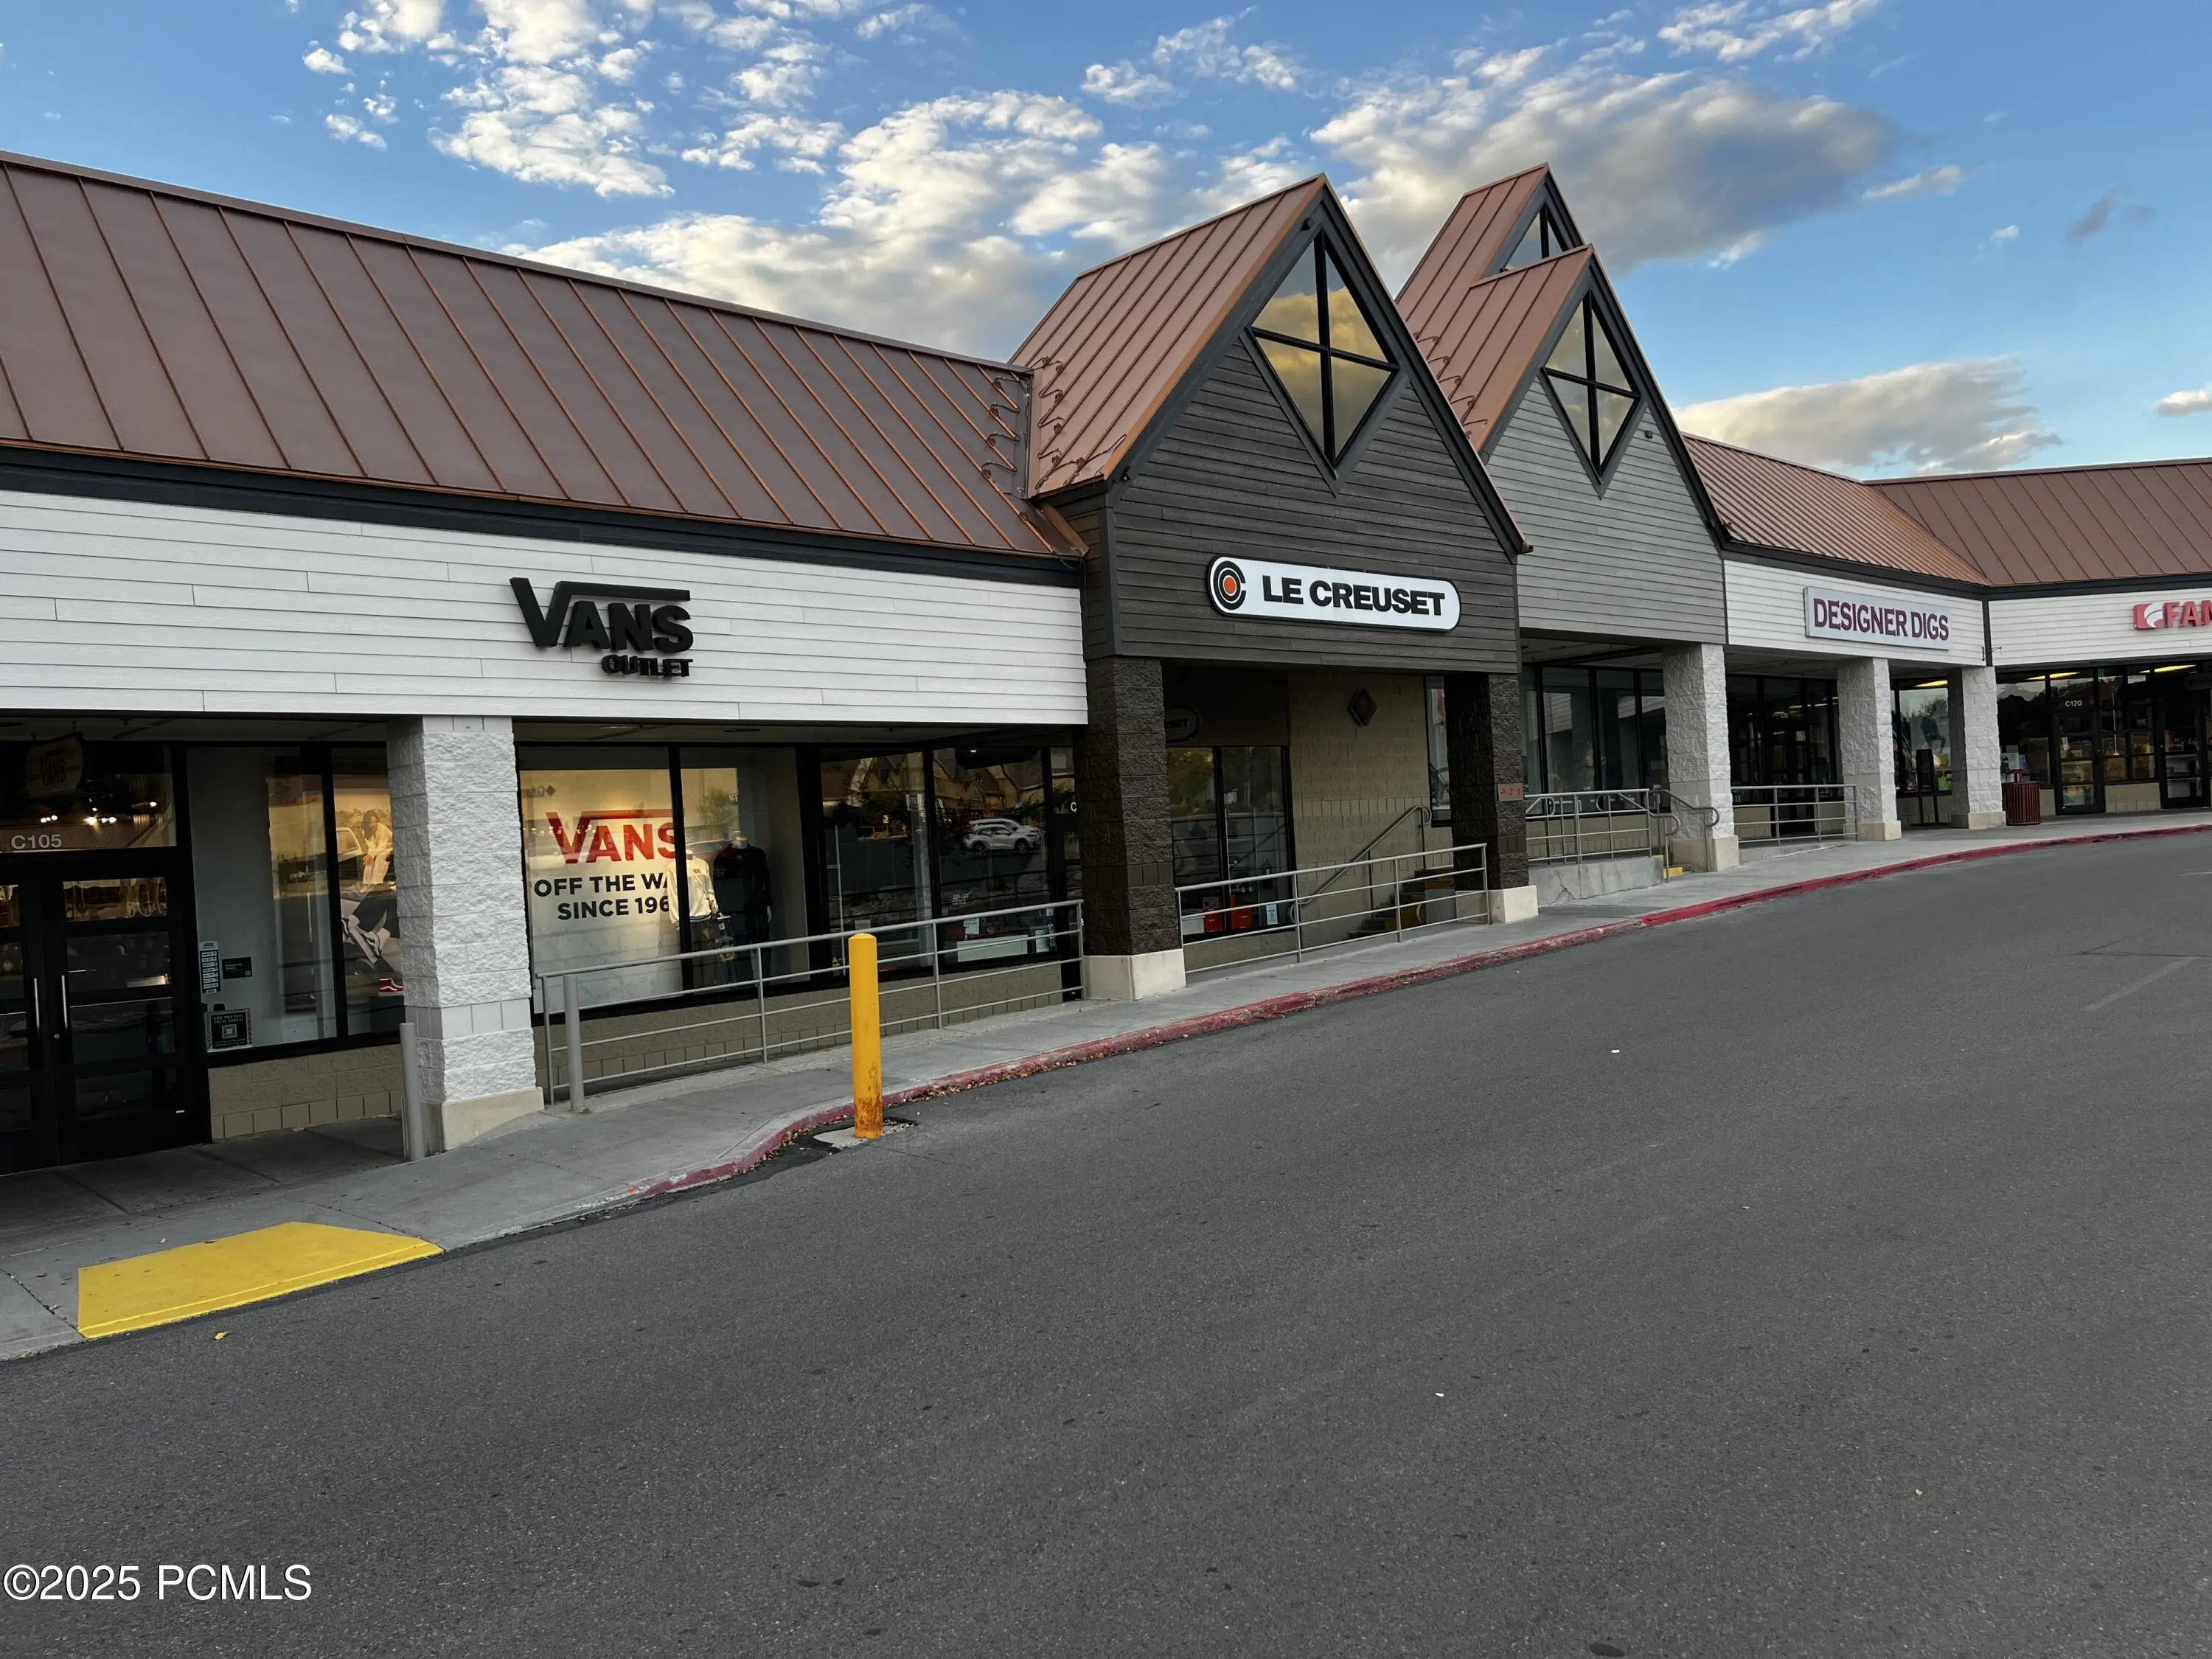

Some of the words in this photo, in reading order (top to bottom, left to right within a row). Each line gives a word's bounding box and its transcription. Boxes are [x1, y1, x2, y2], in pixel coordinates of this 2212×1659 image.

[1262, 574, 1304, 605] LE
[1310, 578, 1446, 616] CREUSET
[509, 577, 694, 653] VANS
[1813, 597, 1908, 637] DESIGNER
[1910, 611, 1950, 641] DIGS
[600, 653, 694, 678] OUTLET
[2065, 699, 2083, 708] C120
[10, 833, 63, 849] C105
[546, 807, 677, 865] VANS
[589, 874, 636, 893] THE
[557, 898, 629, 920] SINCE
